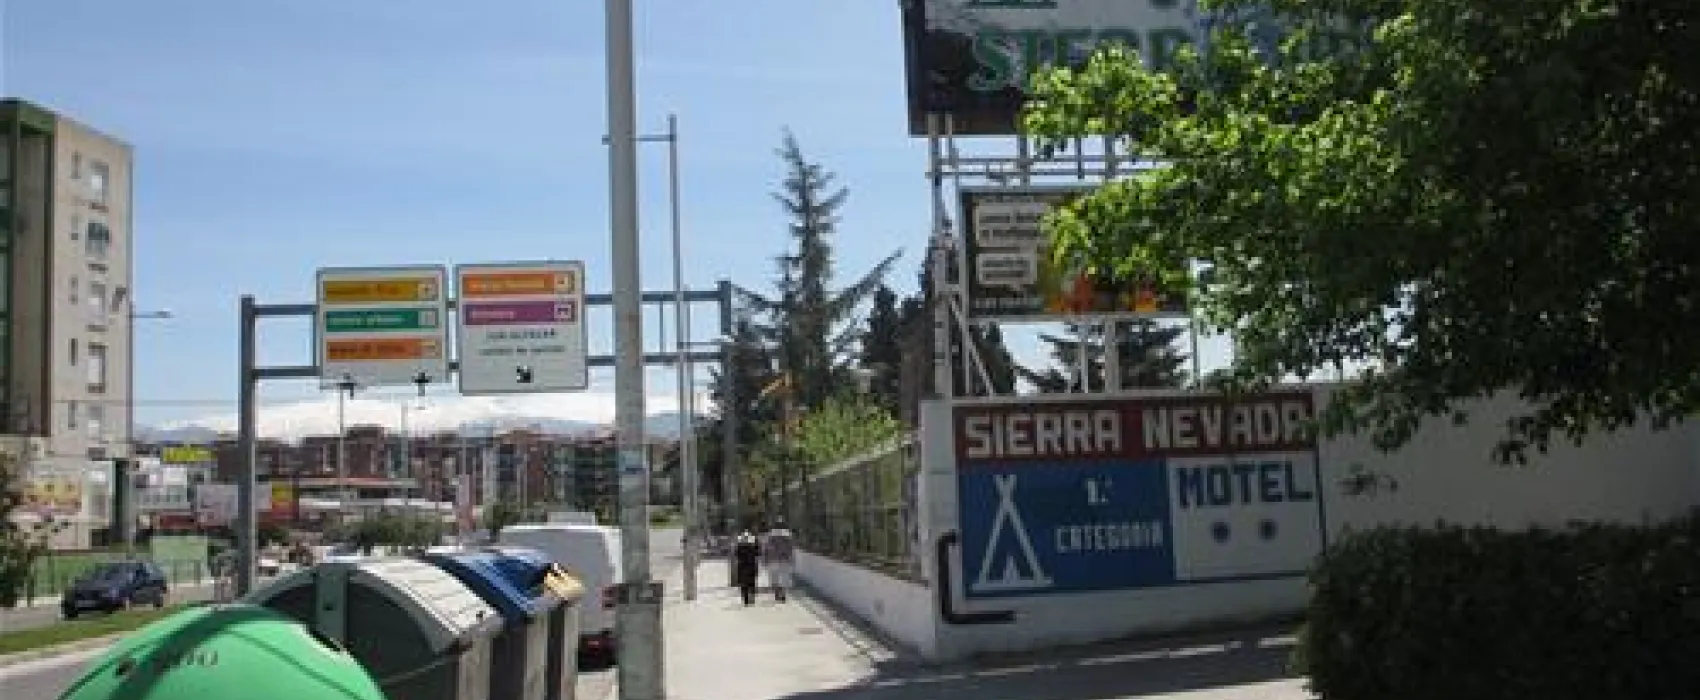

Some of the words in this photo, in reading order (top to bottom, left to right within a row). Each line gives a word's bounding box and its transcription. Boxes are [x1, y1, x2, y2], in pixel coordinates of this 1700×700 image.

[964, 410, 1122, 459] SIERRA
[1142, 402, 1309, 449] NEVADA
[1177, 461, 1314, 510] MOTEL
[1055, 520, 1164, 554] CATEGORIA
